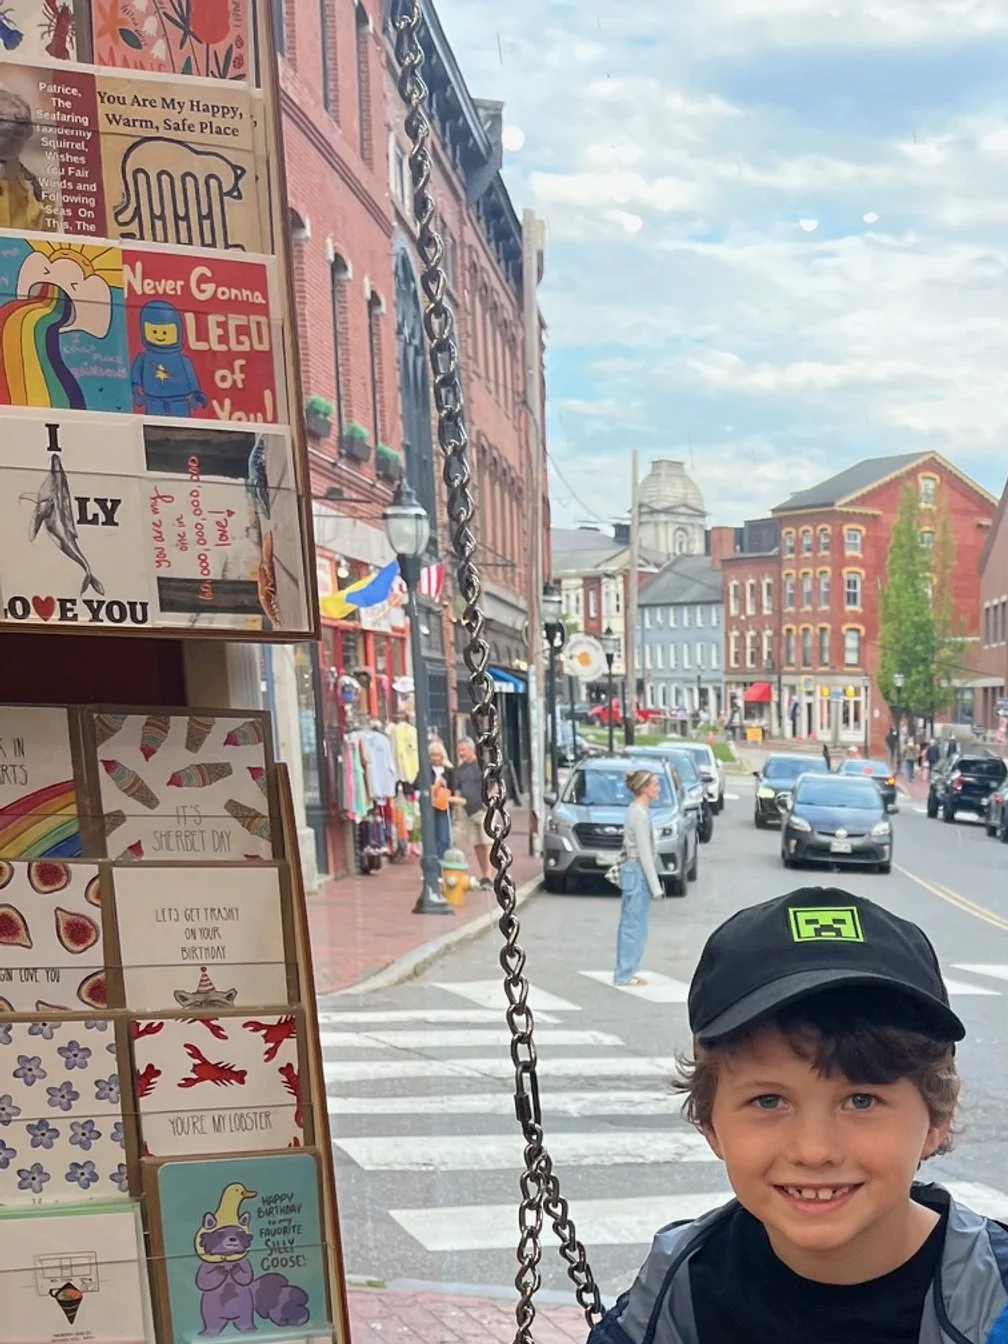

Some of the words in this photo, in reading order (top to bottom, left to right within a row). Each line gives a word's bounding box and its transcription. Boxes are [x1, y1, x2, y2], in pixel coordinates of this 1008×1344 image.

[38, 81, 82, 98] Patrice,
[50, 97, 72, 109] The
[97, 90, 127, 106] You
[131, 94, 157, 108] Are
[161, 97, 185, 114] My
[189, 99, 243, 120] Happy,
[35, 109, 89, 127] Seafaring
[105, 113, 159, 132] Warm,
[163, 118, 196, 133] Safe
[199, 121, 240, 137] Place
[40, 136, 88, 153] Squirrel,
[45, 151, 86, 164] Wishes
[68, 166, 89, 178] Fair
[76, 182, 97, 192] and
[45, 204, 73, 217] Seas
[78, 207, 95, 218] On
[75, 220, 96, 232] The
[123, 261, 185, 299] Never
[189, 265, 266, 304] Gonna
[184, 312, 270, 351] LEGO
[214, 359, 247, 389] of
[45, 423, 62, 452] I
[149, 485, 175, 515] my
[75, 497, 122, 526] LY
[173, 513, 186, 528] in
[151, 519, 165, 542] are
[176, 531, 189, 552] one
[155, 546, 171, 568] you
[82, 599, 149, 624] YOU
[12, 737, 25, 758] IN
[0, 764, 28, 786] RTS
[176, 804, 202, 826] IT'S
[152, 829, 207, 852] SHERBET
[211, 829, 232, 853] DAY
[155, 908, 180, 923] LETS
[184, 907, 200, 922] GET
[184, 927, 197, 940] ON
[198, 926, 222, 940] YOUR
[181, 945, 226, 960] BIRTHDAY
[19, 967, 40, 983] LOVE
[45, 967, 60, 983] YOU
[168, 1114, 207, 1136] YOU'RE
[211, 1114, 226, 1133] MY
[229, 1110, 272, 1133] LOBSTER
[261, 1192, 294, 1206] HAPPY
[257, 1202, 303, 1219] BIRTHDAY
[259, 1224, 303, 1238] FAVORITE
[264, 1238, 295, 1257] SILLY
